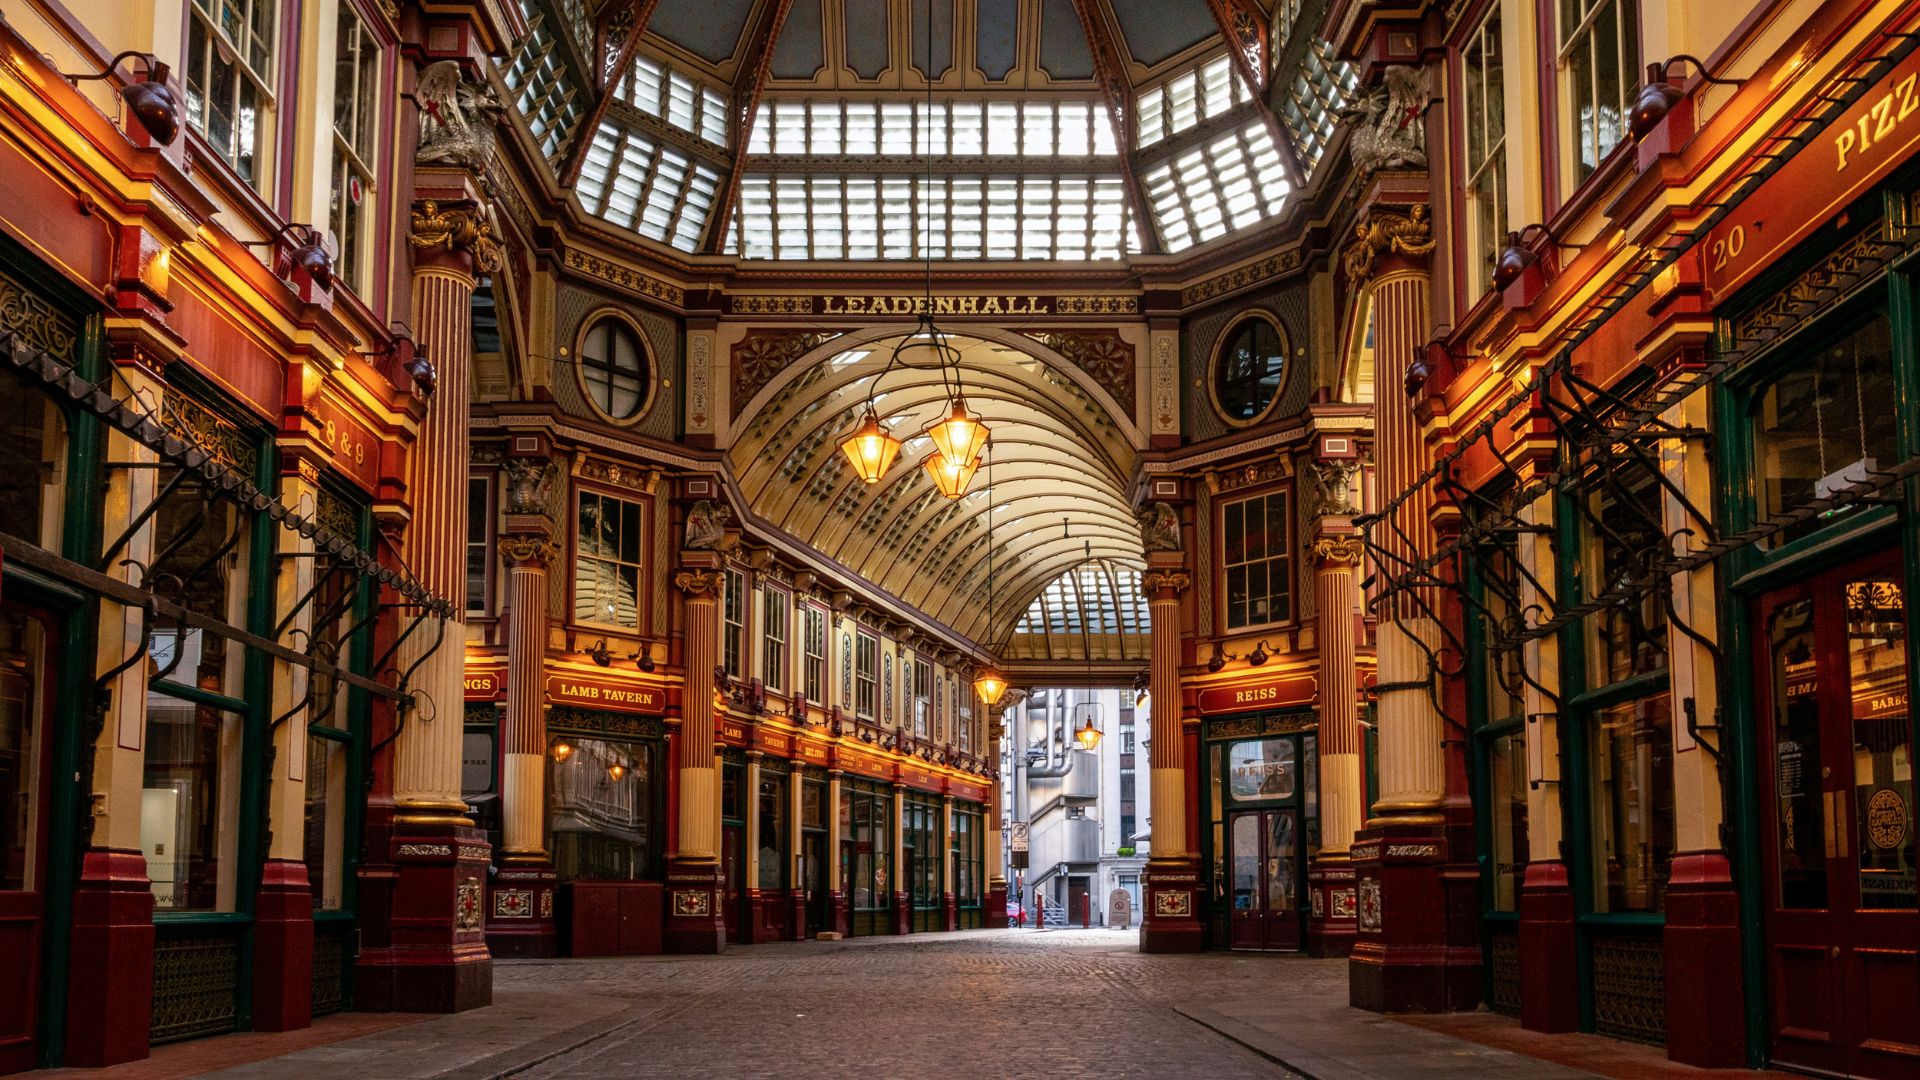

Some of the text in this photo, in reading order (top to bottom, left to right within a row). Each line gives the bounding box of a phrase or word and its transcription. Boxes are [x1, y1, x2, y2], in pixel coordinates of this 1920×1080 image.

[1835, 72, 1919, 172] PIZZ
[1713, 225, 1745, 272] 20
[823, 297, 1048, 314] LEADENHALL
[326, 420, 364, 465] 8 & 9
[561, 684, 652, 705] LAMB TAVERN
[1236, 687, 1277, 703] REISS
[724, 727, 743, 739] LAMB
[764, 736, 785, 749] TAVERN
[1237, 764, 1285, 777] REISS
